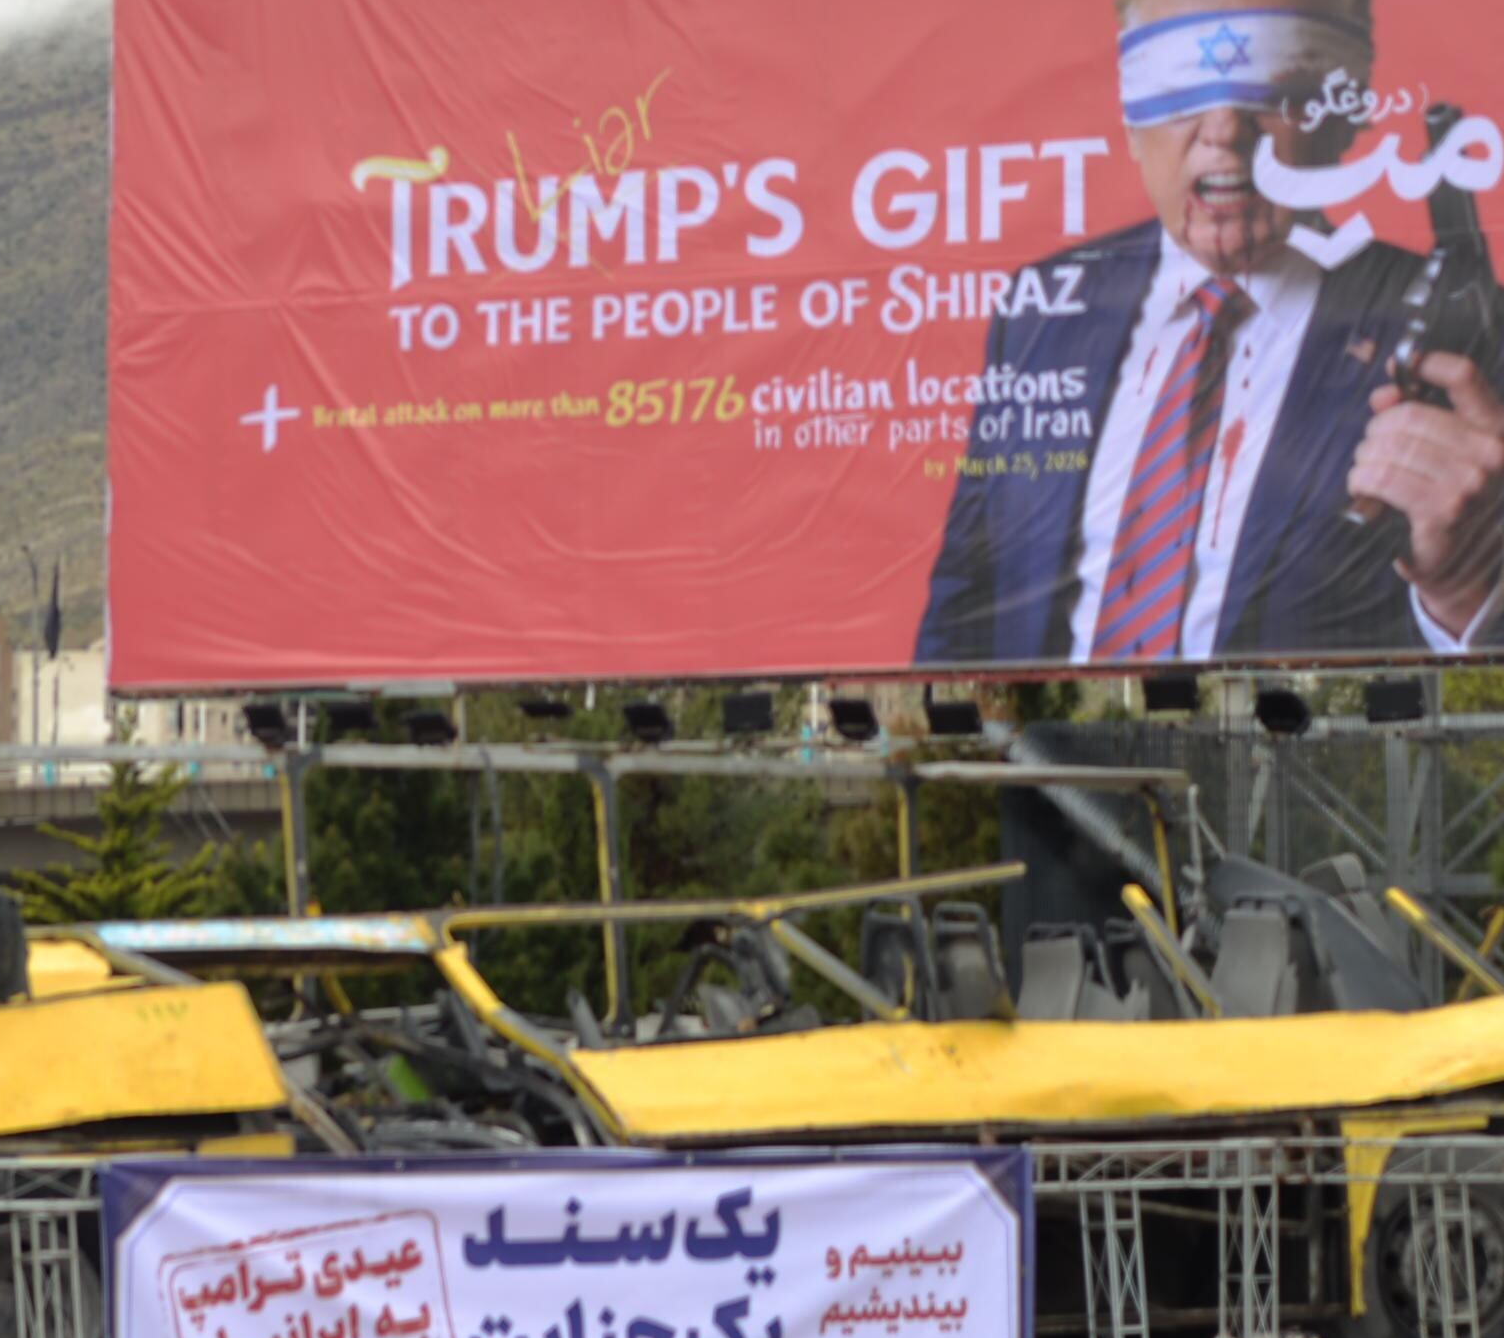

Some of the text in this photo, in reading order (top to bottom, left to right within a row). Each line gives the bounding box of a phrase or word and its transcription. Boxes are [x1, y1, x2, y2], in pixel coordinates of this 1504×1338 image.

[506, 66, 674, 223] Liar
[852, 137, 1109, 250] GIFT
[390, 304, 459, 350] TO
[477, 298, 571, 345] THE
[593, 285, 778, 340] PEOPLE
[800, 279, 869, 327] OF
[383, 397, 449, 425] attack
[454, 402, 483, 421] on
[488, 398, 546, 421] more
[549, 390, 600, 418] than
[605, 374, 747, 427] 85176
[751, 367, 894, 414] civilian
[907, 358, 1088, 406] locations
[754, 406, 1092, 452] in other parts of Iran
[924, 457, 946, 478] by
[955, 454, 1008, 477] March
[1044, 448, 1088, 471] 2026
[462, 1187, 781, 1287] یک سند
[826, 1236, 964, 1280] ببینیم و
[177, 1237, 424, 1332] عیدی ترامپ
[819, 1287, 969, 1336] بیندیشیم
